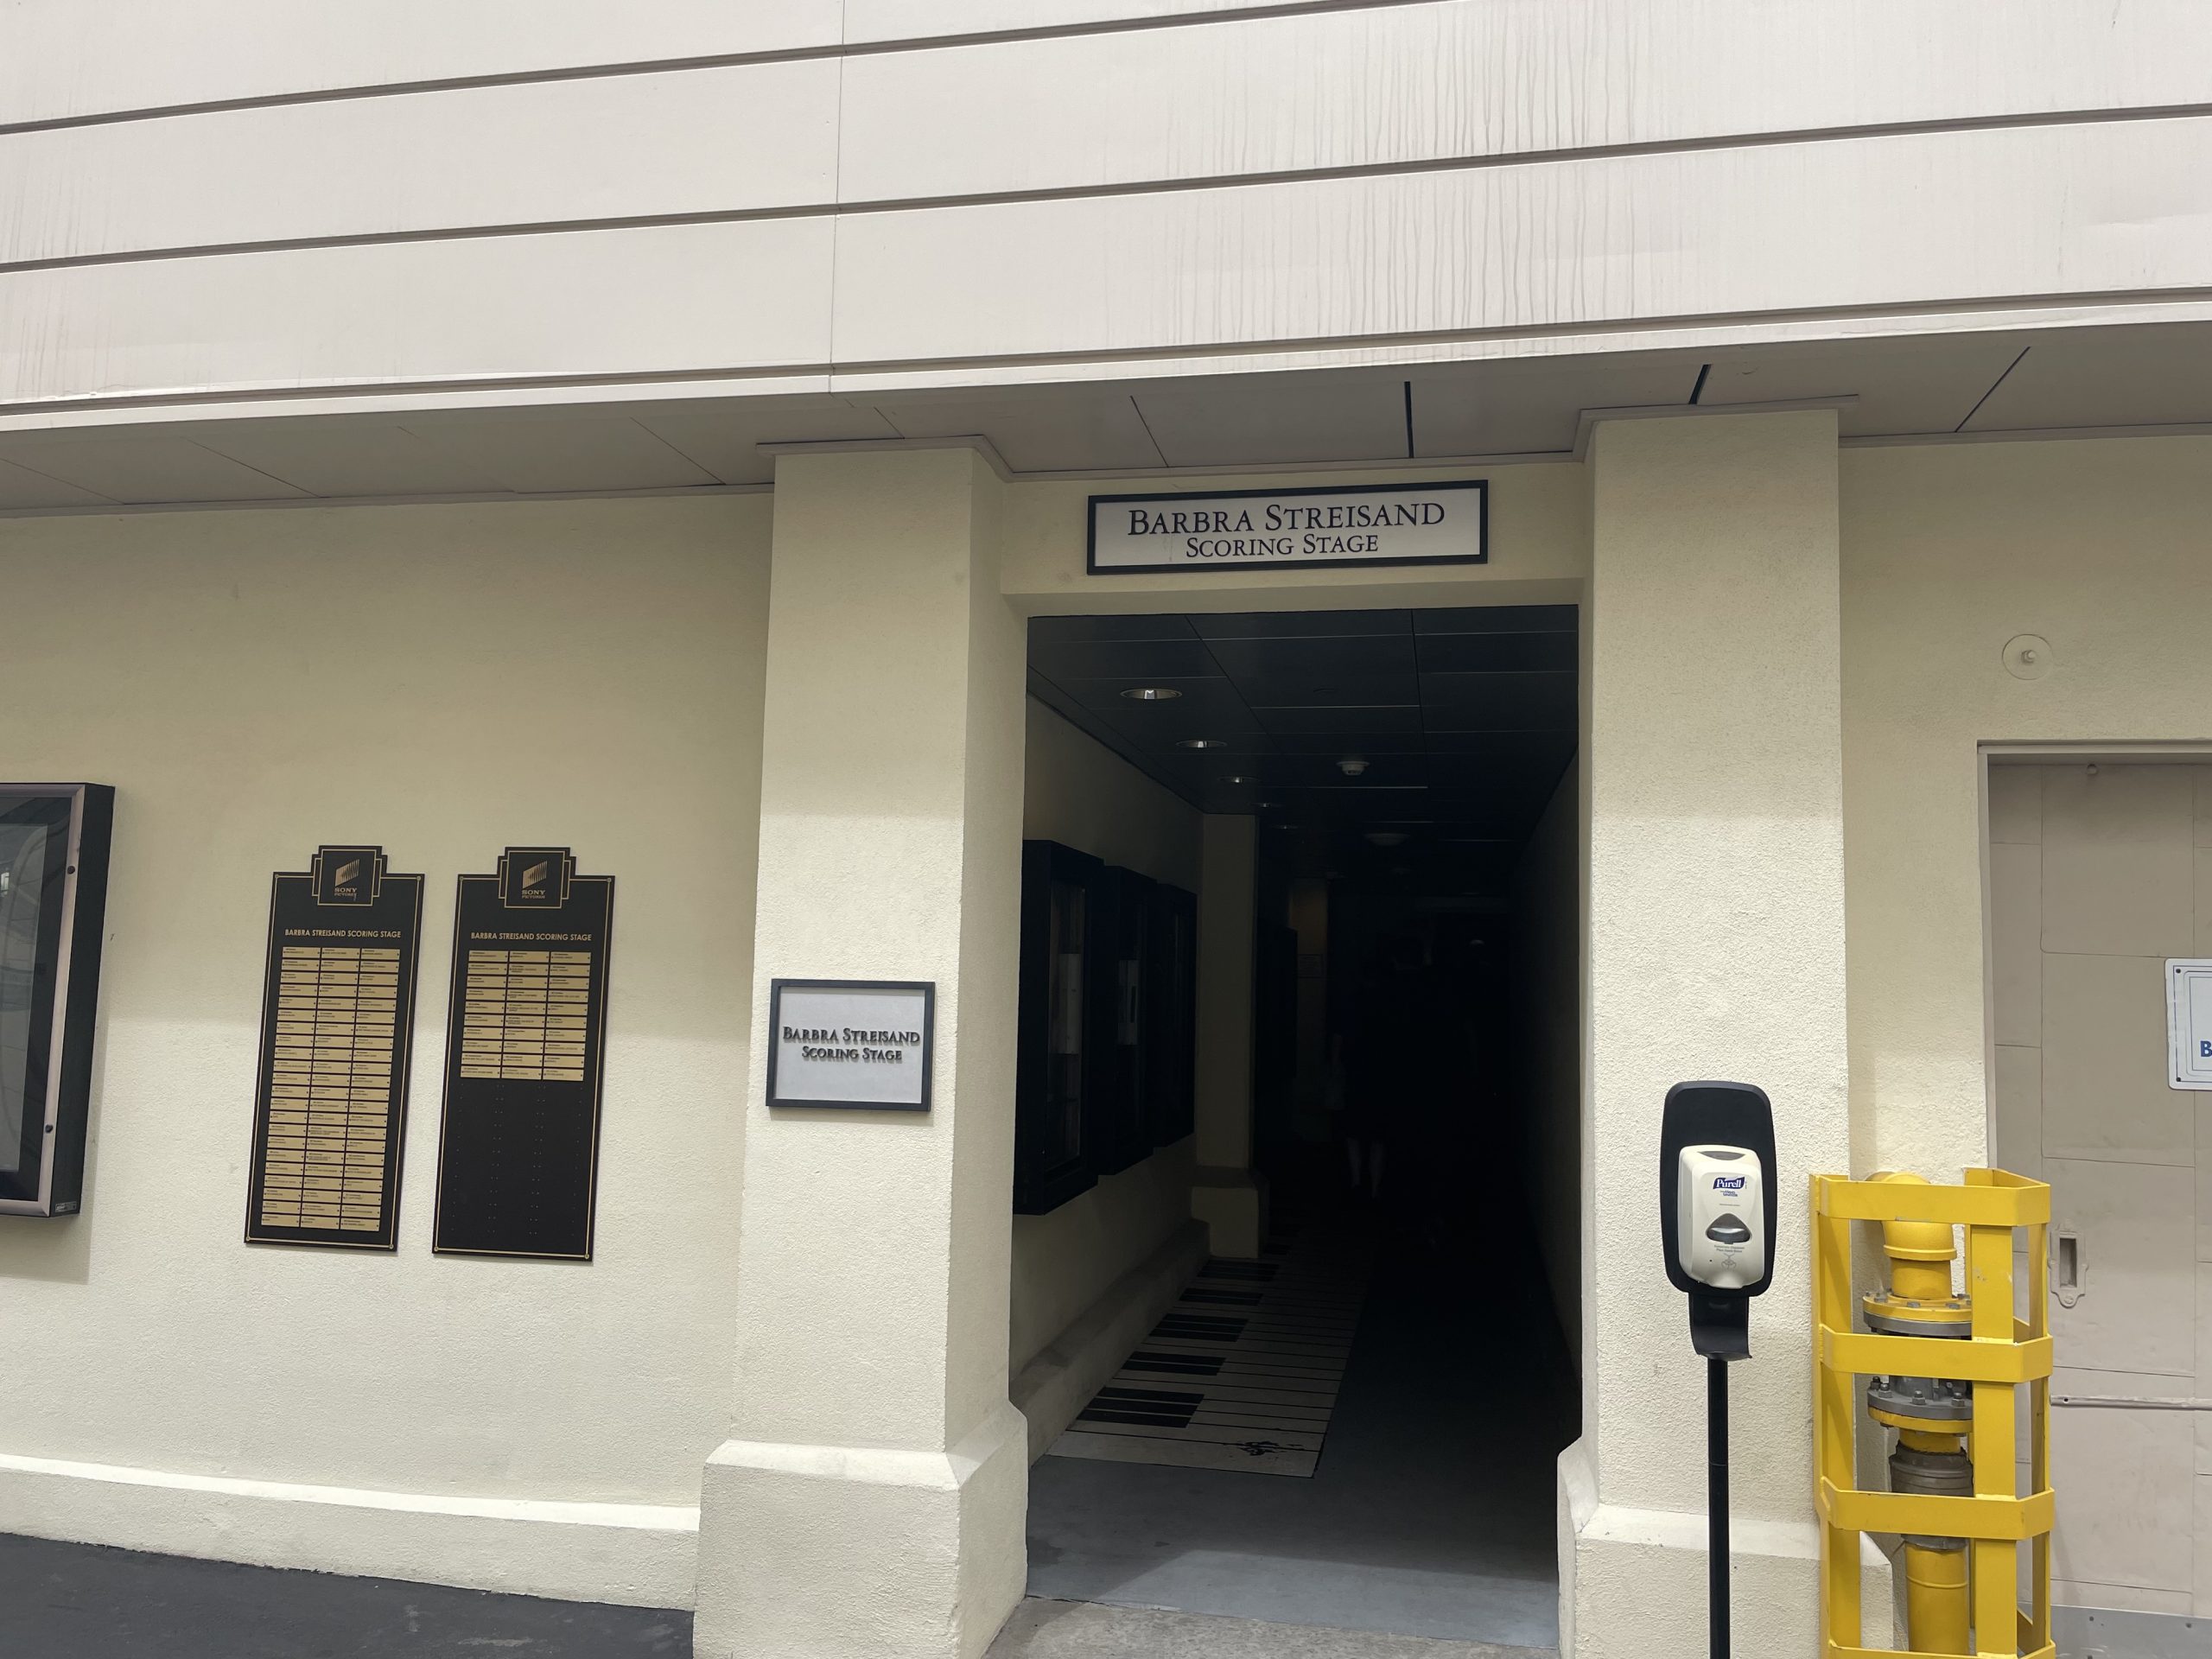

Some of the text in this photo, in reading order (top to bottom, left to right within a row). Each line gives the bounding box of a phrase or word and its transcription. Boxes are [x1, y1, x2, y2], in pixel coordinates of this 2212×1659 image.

[1128, 502, 1446, 536] BARBRA STREISAND
[1185, 534, 1379, 557] SCORING STAGE
[312, 929, 346, 938] STREISAND
[783, 1027, 920, 1043] BARBRA STREISAND
[802, 1046, 902, 1061] SCORING STAGE
